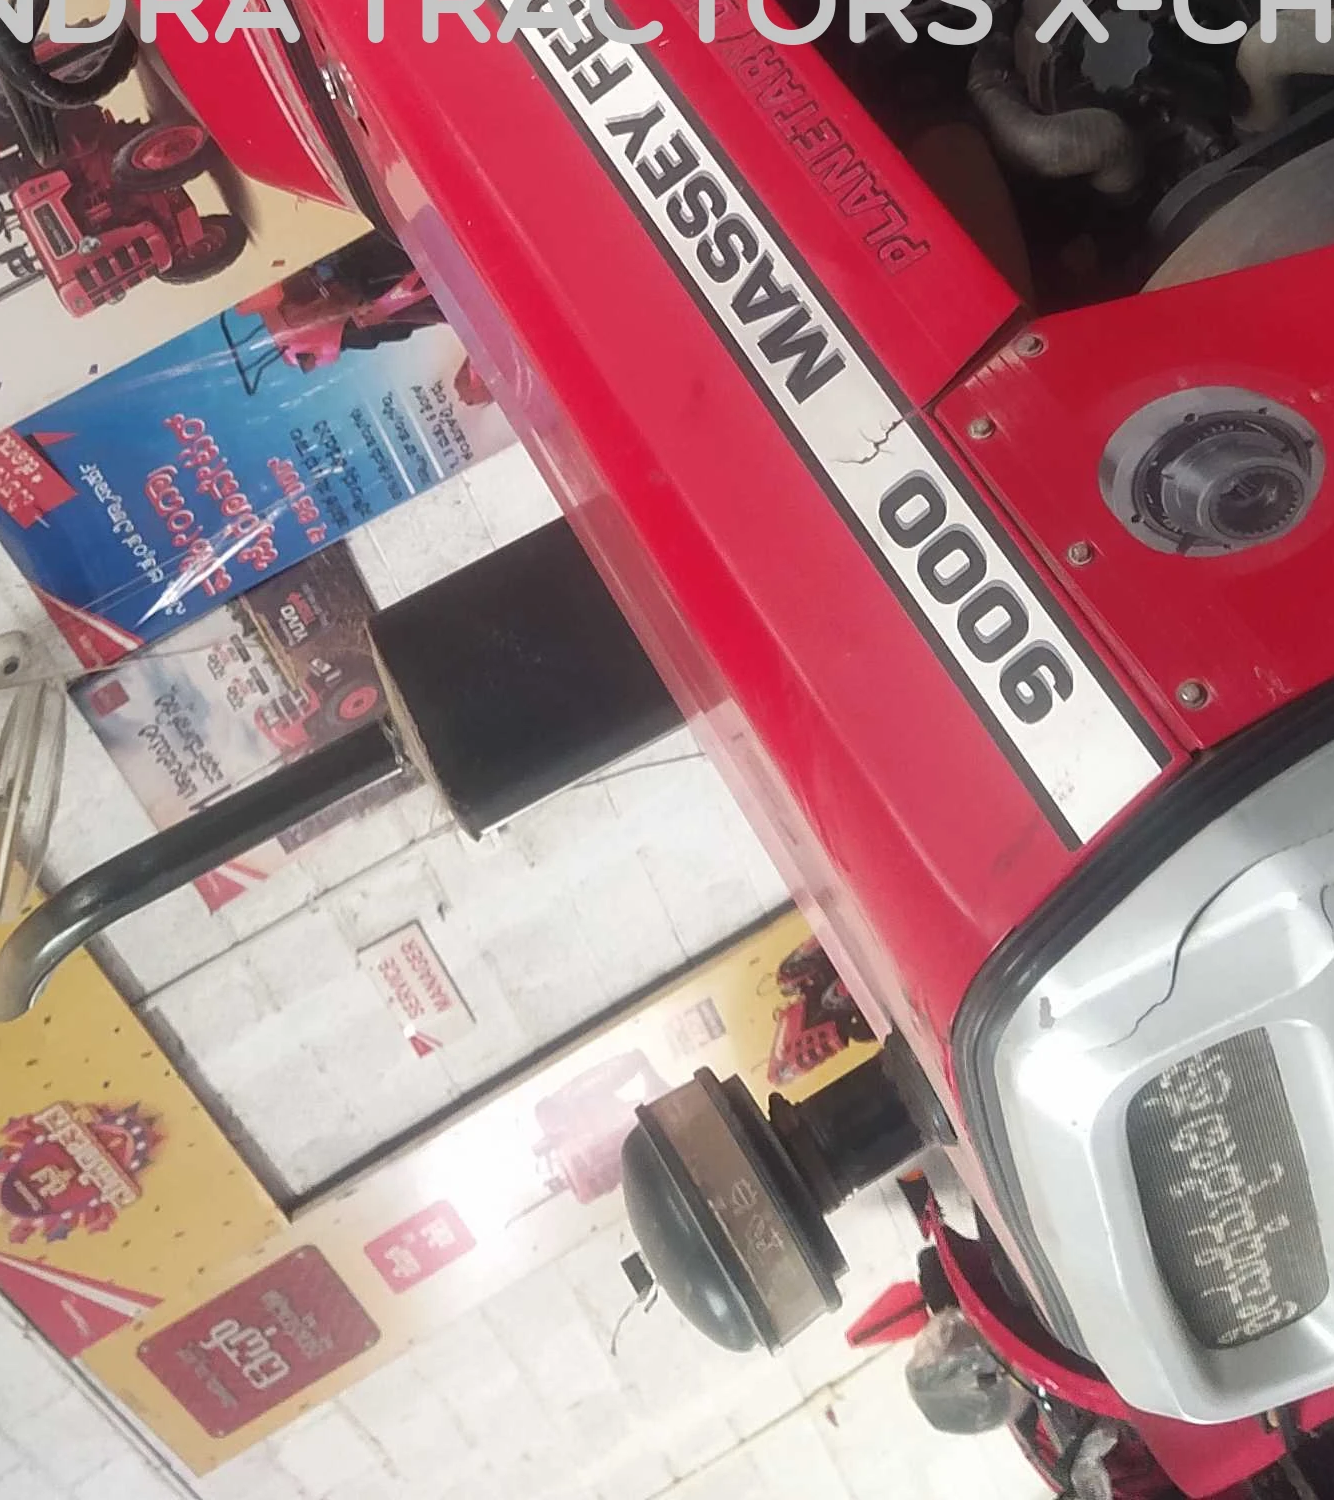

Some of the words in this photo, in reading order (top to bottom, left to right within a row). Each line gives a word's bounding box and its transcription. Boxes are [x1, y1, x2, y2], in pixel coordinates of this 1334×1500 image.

[601, 91, 850, 404] MASSEY
[278, 601, 309, 643] YUVO
[865, 459, 1085, 734] 9000
[375, 953, 426, 1021] SERVICE
[398, 935, 454, 1014] MANAGER
